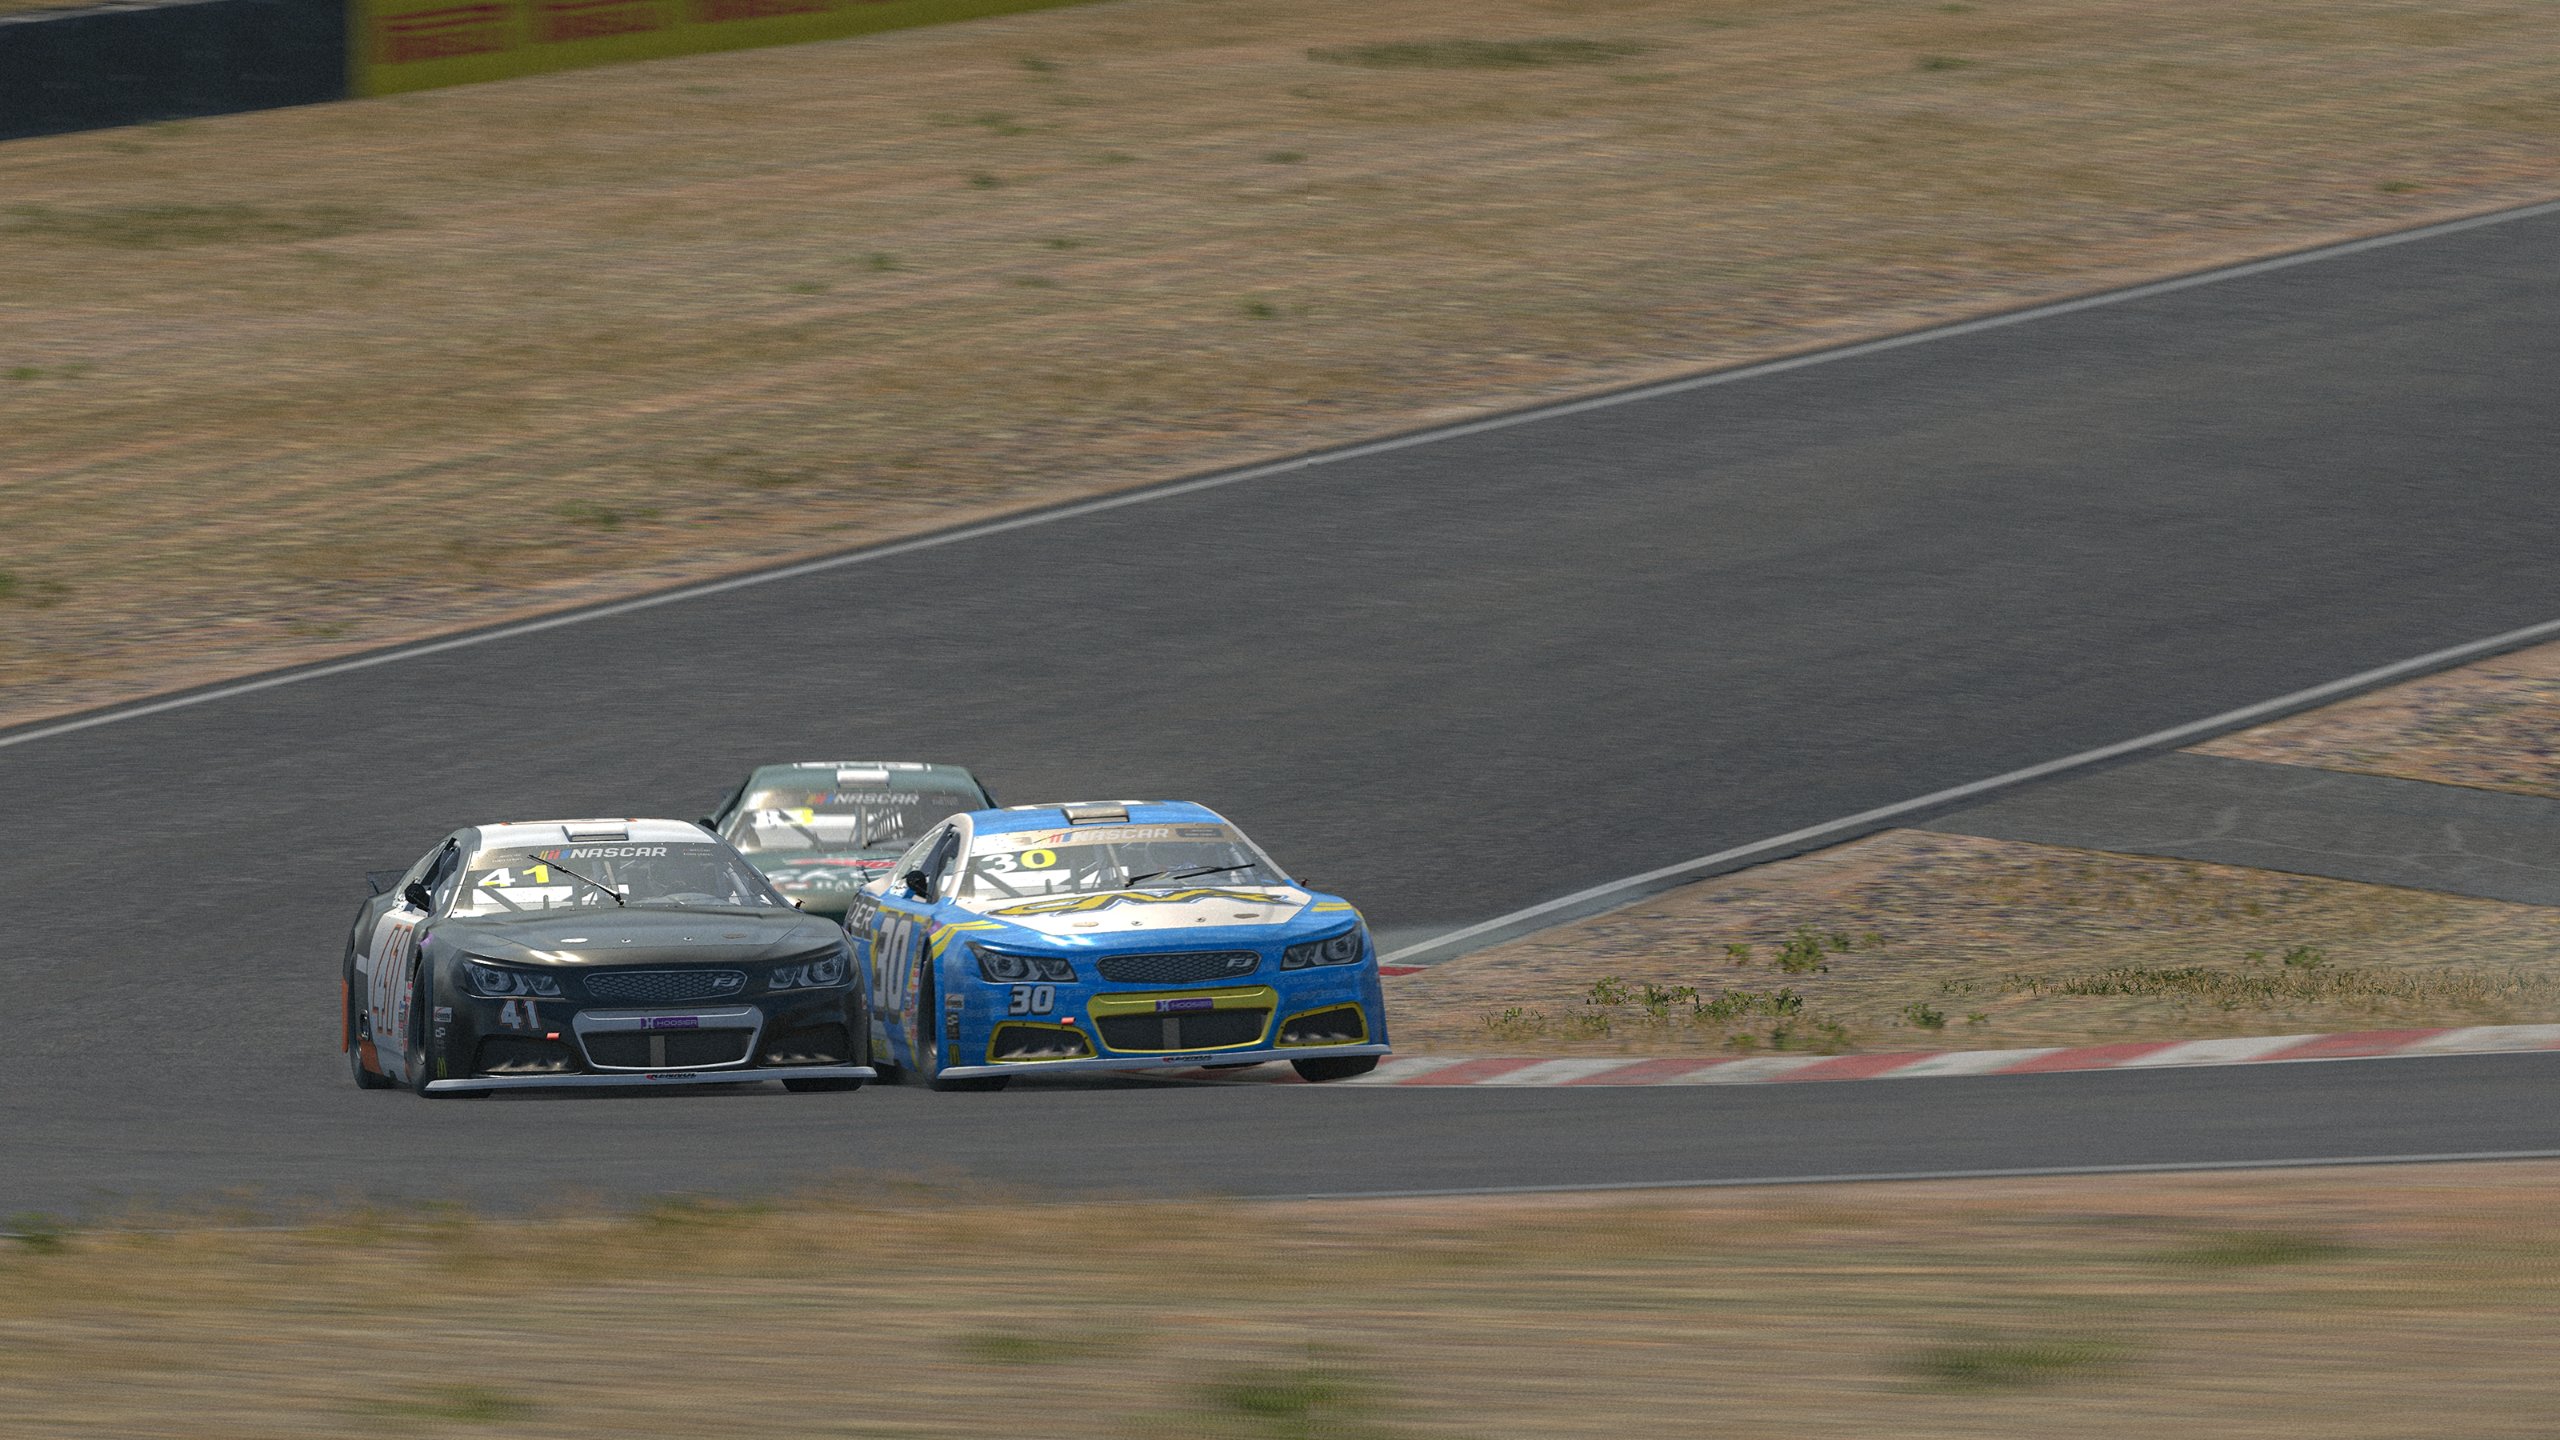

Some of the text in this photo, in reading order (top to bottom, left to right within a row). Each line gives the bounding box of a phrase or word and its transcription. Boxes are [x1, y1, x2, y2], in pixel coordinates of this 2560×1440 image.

[833, 793, 920, 805] NASCAR
[1069, 827, 1169, 843] NASCAR
[570, 847, 667, 859] NASCAR
[980, 848, 1057, 874] 30
[873, 910, 914, 1024] 30
[1008, 984, 1055, 1016] 30
[500, 999, 542, 1031] 41
[656, 1018, 698, 1027] HOOSIER
